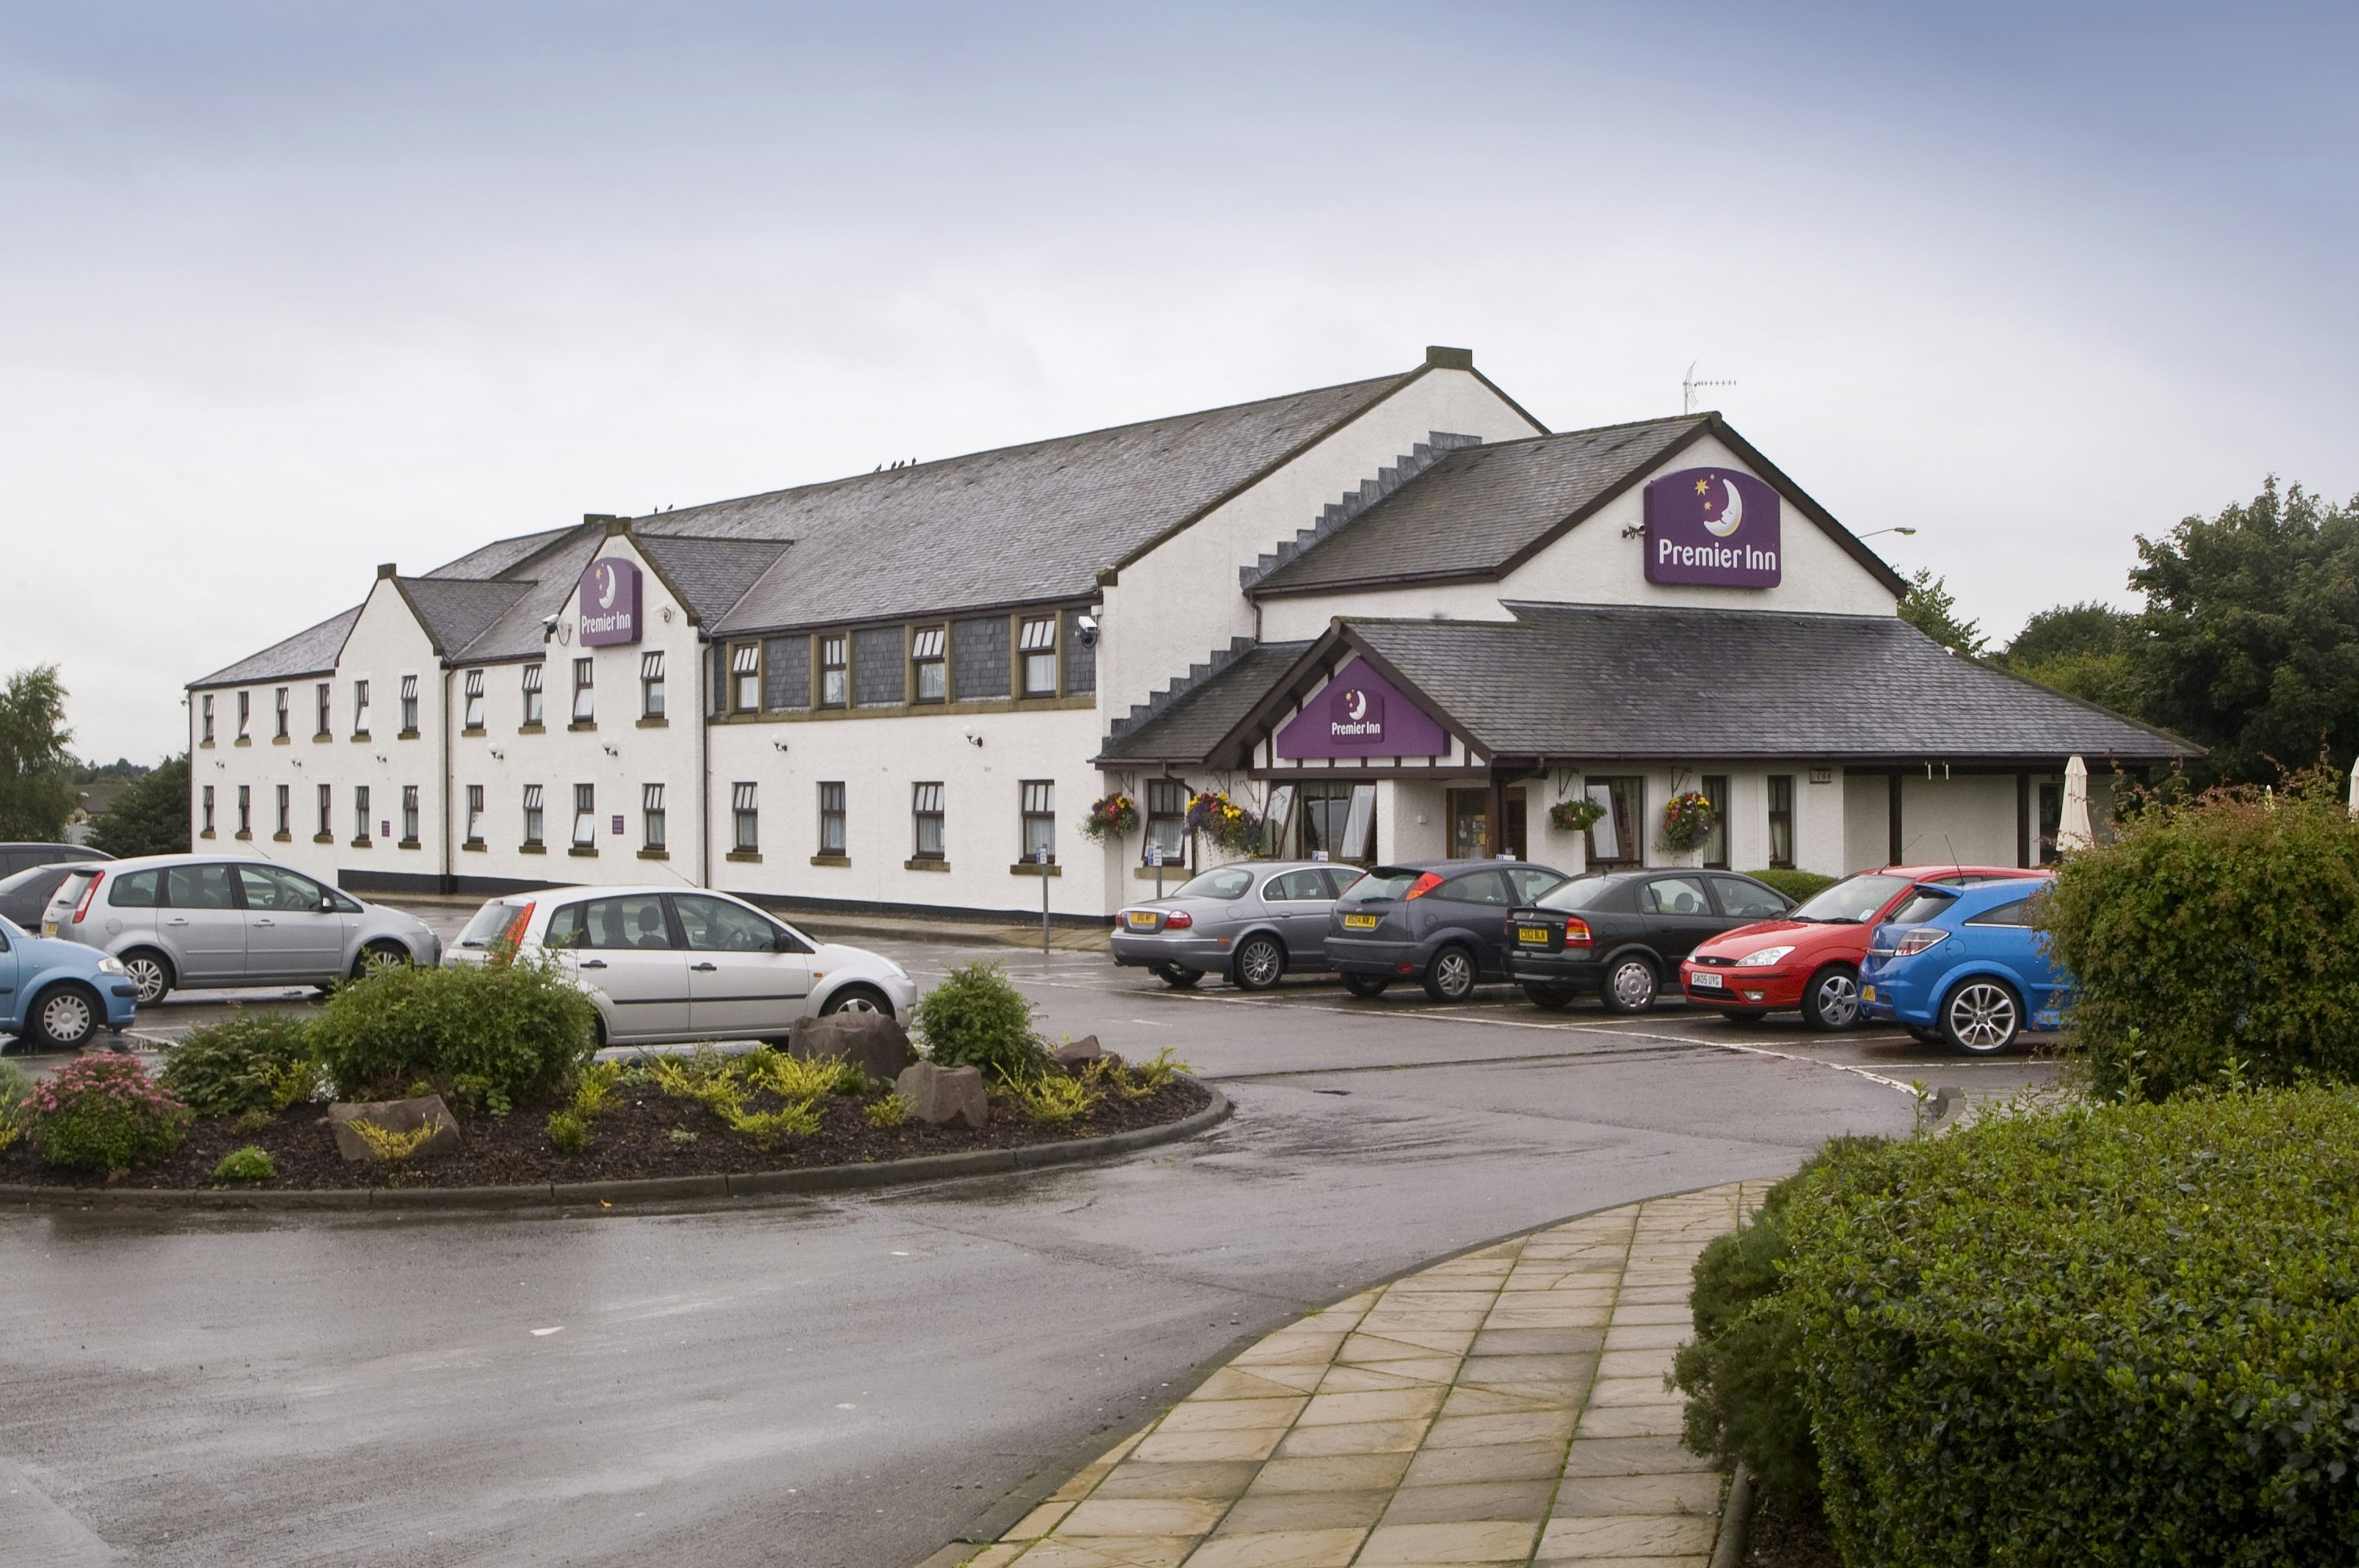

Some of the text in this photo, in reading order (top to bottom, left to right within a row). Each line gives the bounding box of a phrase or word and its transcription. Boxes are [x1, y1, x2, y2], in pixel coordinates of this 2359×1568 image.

[1659, 539, 1776, 571] Premier Inn
[581, 611, 631, 634] Premier Inn
[1331, 721, 1380, 735] Premier Inn
[1693, 973, 1719, 985] SK05 UYG
